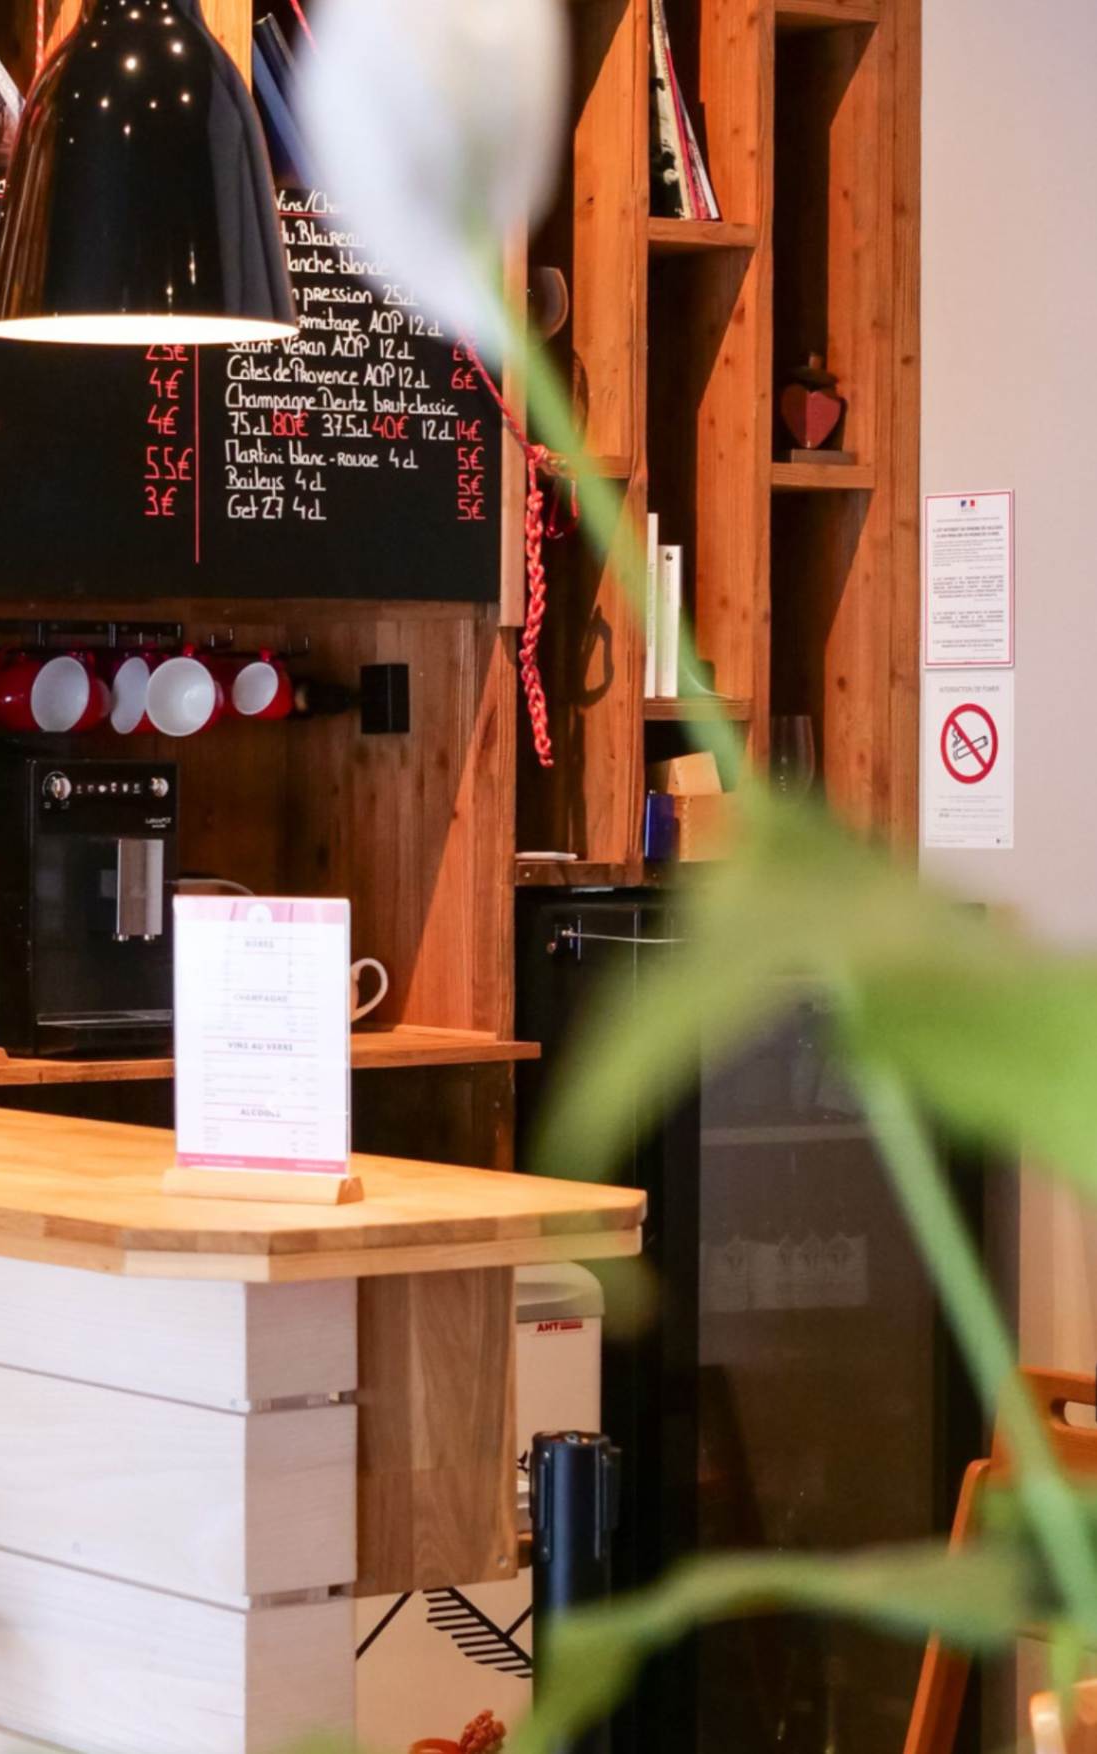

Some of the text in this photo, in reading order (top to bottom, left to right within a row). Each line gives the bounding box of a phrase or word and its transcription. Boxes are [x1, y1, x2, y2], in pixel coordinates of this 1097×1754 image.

[297, 306, 362, 342] rmitage
[368, 309, 404, 335] AOP
[331, 333, 370, 358] AOP
[149, 367, 184, 399] 4€
[273, 357, 292, 382] de
[289, 357, 360, 386] Provence
[362, 362, 396, 388] AOP
[225, 382, 318, 419] Champagne
[317, 386, 369, 412] Deutz
[147, 404, 180, 435] 4€
[225, 438, 285, 465] Martini
[457, 446, 485, 470] 5€
[225, 465, 286, 498] Baileys
[456, 474, 484, 496] 5€
[144, 486, 178, 516] 3€
[456, 498, 486, 521] 5€
